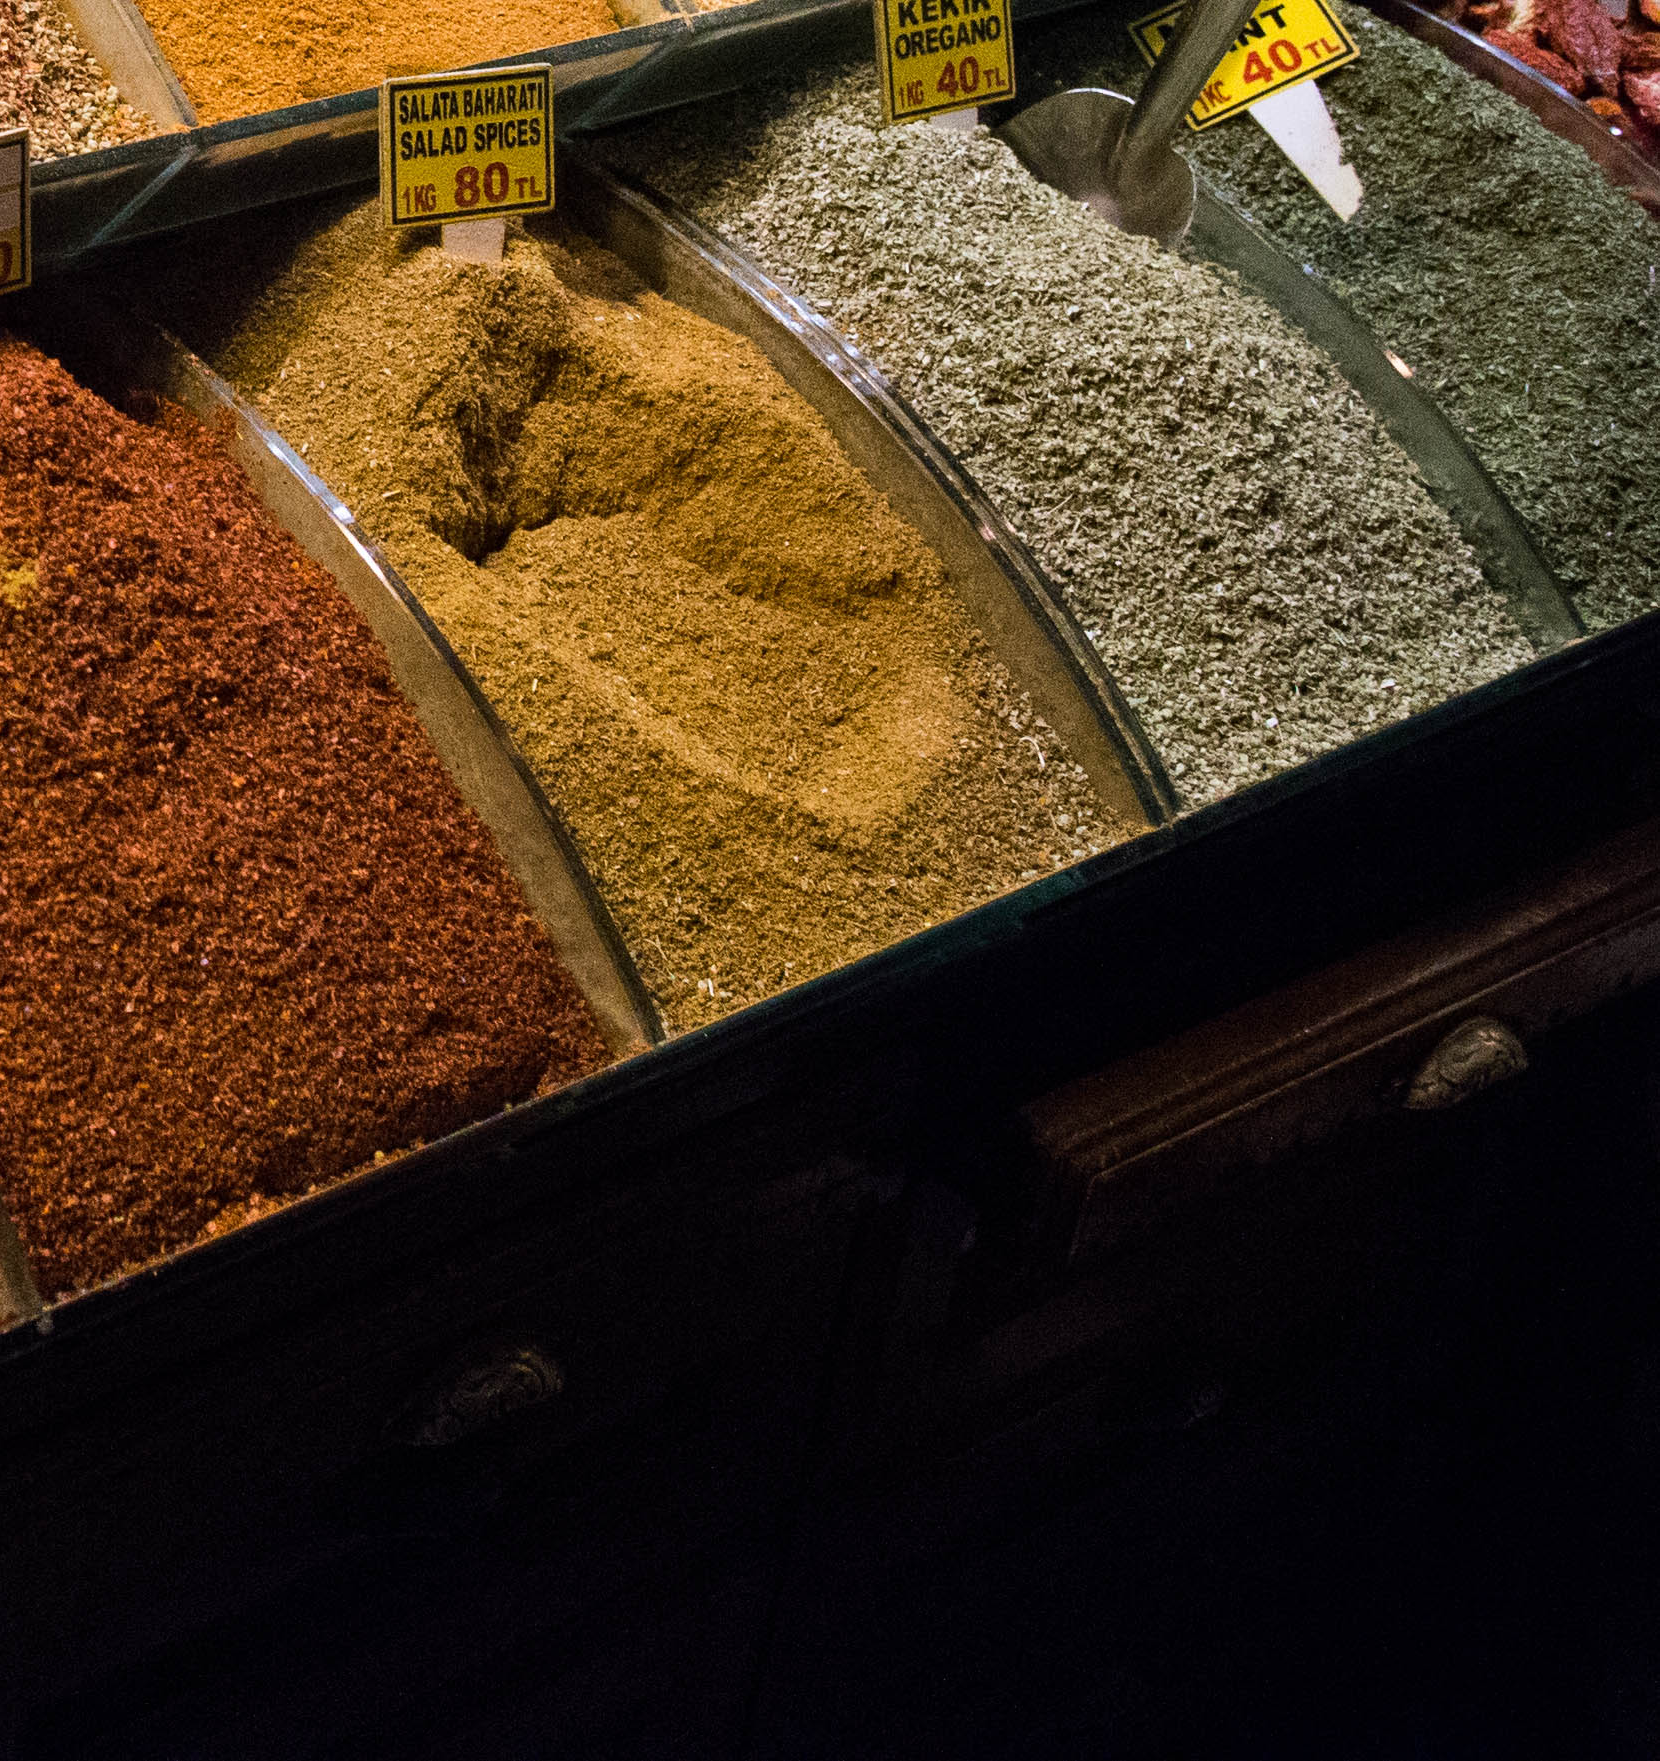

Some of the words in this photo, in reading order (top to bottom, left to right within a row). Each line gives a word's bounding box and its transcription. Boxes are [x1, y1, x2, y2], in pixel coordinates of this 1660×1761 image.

[895, 14, 1001, 60] OREGANO
[936, 55, 982, 99] 40
[982, 66, 1006, 90] TL
[1241, 38, 1303, 86] 40
[1304, 37, 1341, 61] TL
[399, 89, 459, 126] SALATA
[463, 82, 544, 118] BAHARATI
[400, 126, 468, 161] SALAD
[473, 117, 541, 152] SPICES
[454, 161, 510, 208] 80
[513, 176, 544, 200] TL
